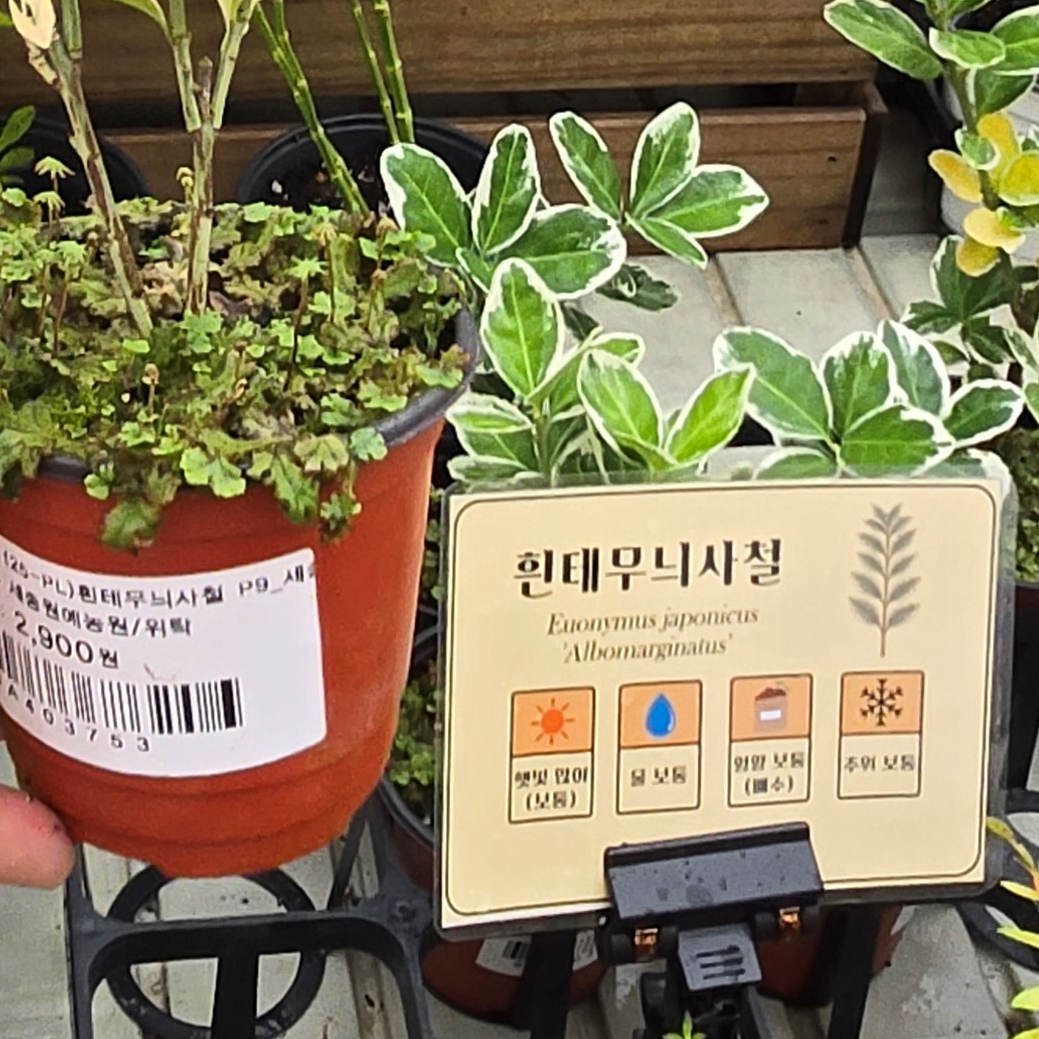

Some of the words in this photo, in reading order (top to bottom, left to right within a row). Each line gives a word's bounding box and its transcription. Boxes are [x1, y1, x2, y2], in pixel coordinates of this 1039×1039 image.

[238, 563, 315, 598] P9_세
[514, 538, 782, 599] 흰테무늬사철
[546, 612, 657, 637] Euonymus
[659, 603, 760, 632] japonicus
[14, 611, 119, 669] 2,900원
[772, 751, 805, 770] 보통
[843, 756, 877, 773] 추위
[881, 754, 916, 771] 보통
[652, 765, 687, 786] 보통
[526, 790, 577, 812] (보통)
